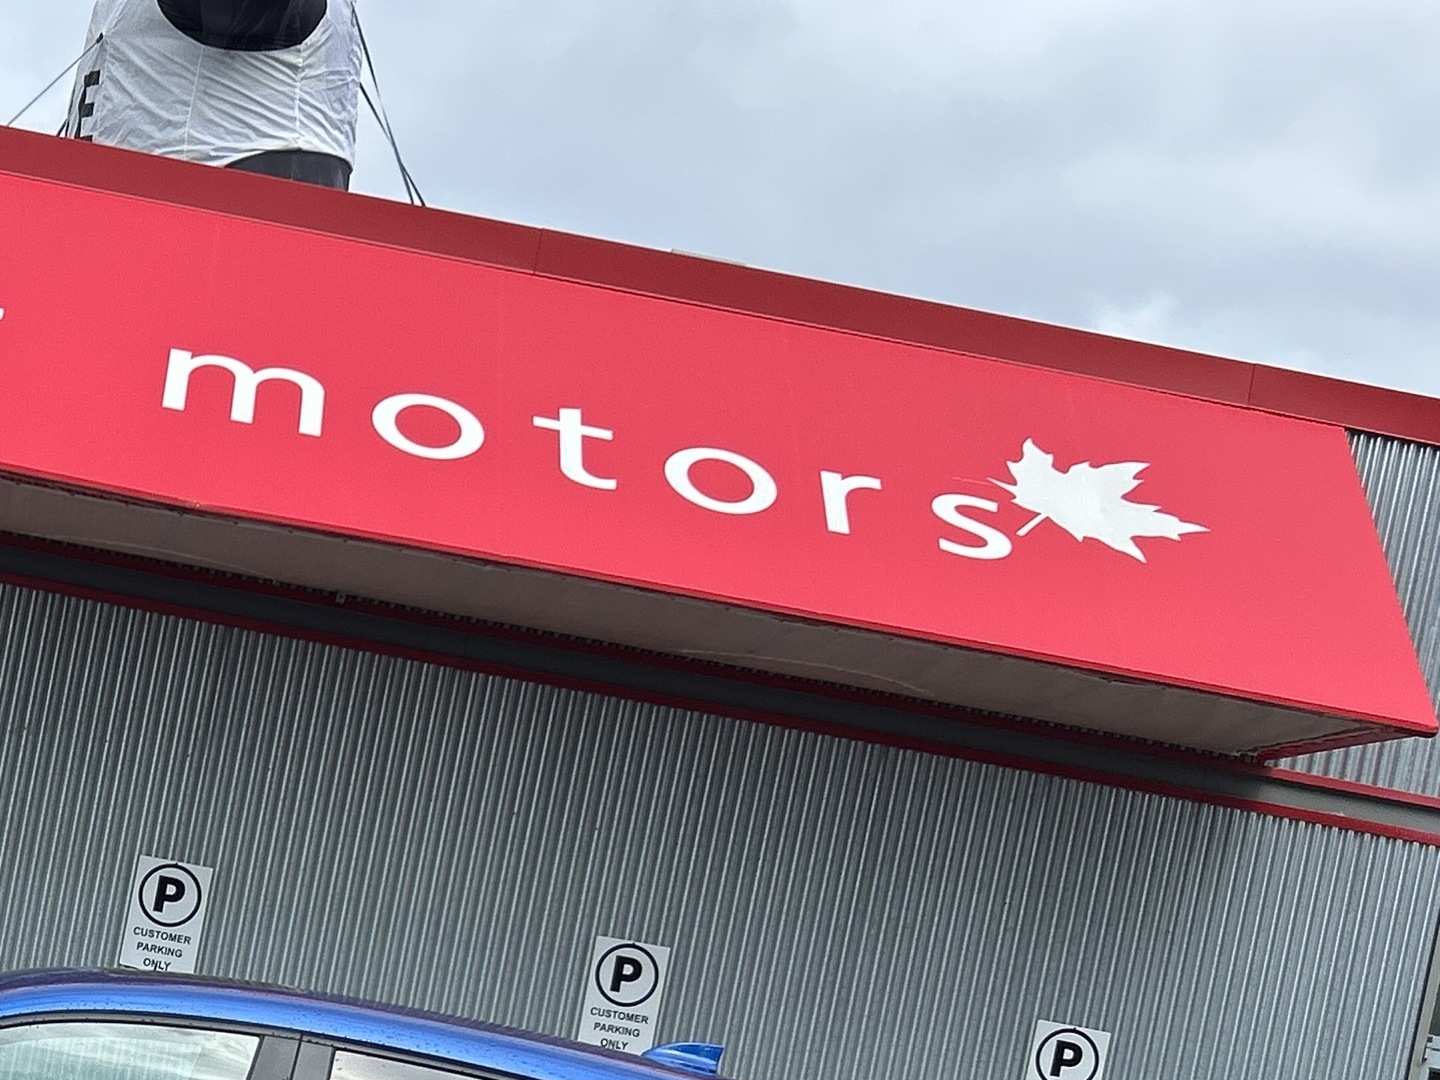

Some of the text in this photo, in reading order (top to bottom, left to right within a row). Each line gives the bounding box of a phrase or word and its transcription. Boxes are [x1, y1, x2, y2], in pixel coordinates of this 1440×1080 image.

[162, 349, 1014, 561] motors
[153, 874, 186, 913] P
[133, 926, 191, 944] CUSTOMER
[136, 941, 183, 958] PARKING
[143, 957, 171, 971] ONLY
[610, 954, 643, 992] P
[590, 1006, 649, 1024] CUSTOMER
[593, 1021, 640, 1038] PARKING
[600, 1037, 628, 1050] ONLY
[1050, 1039, 1083, 1077] P
